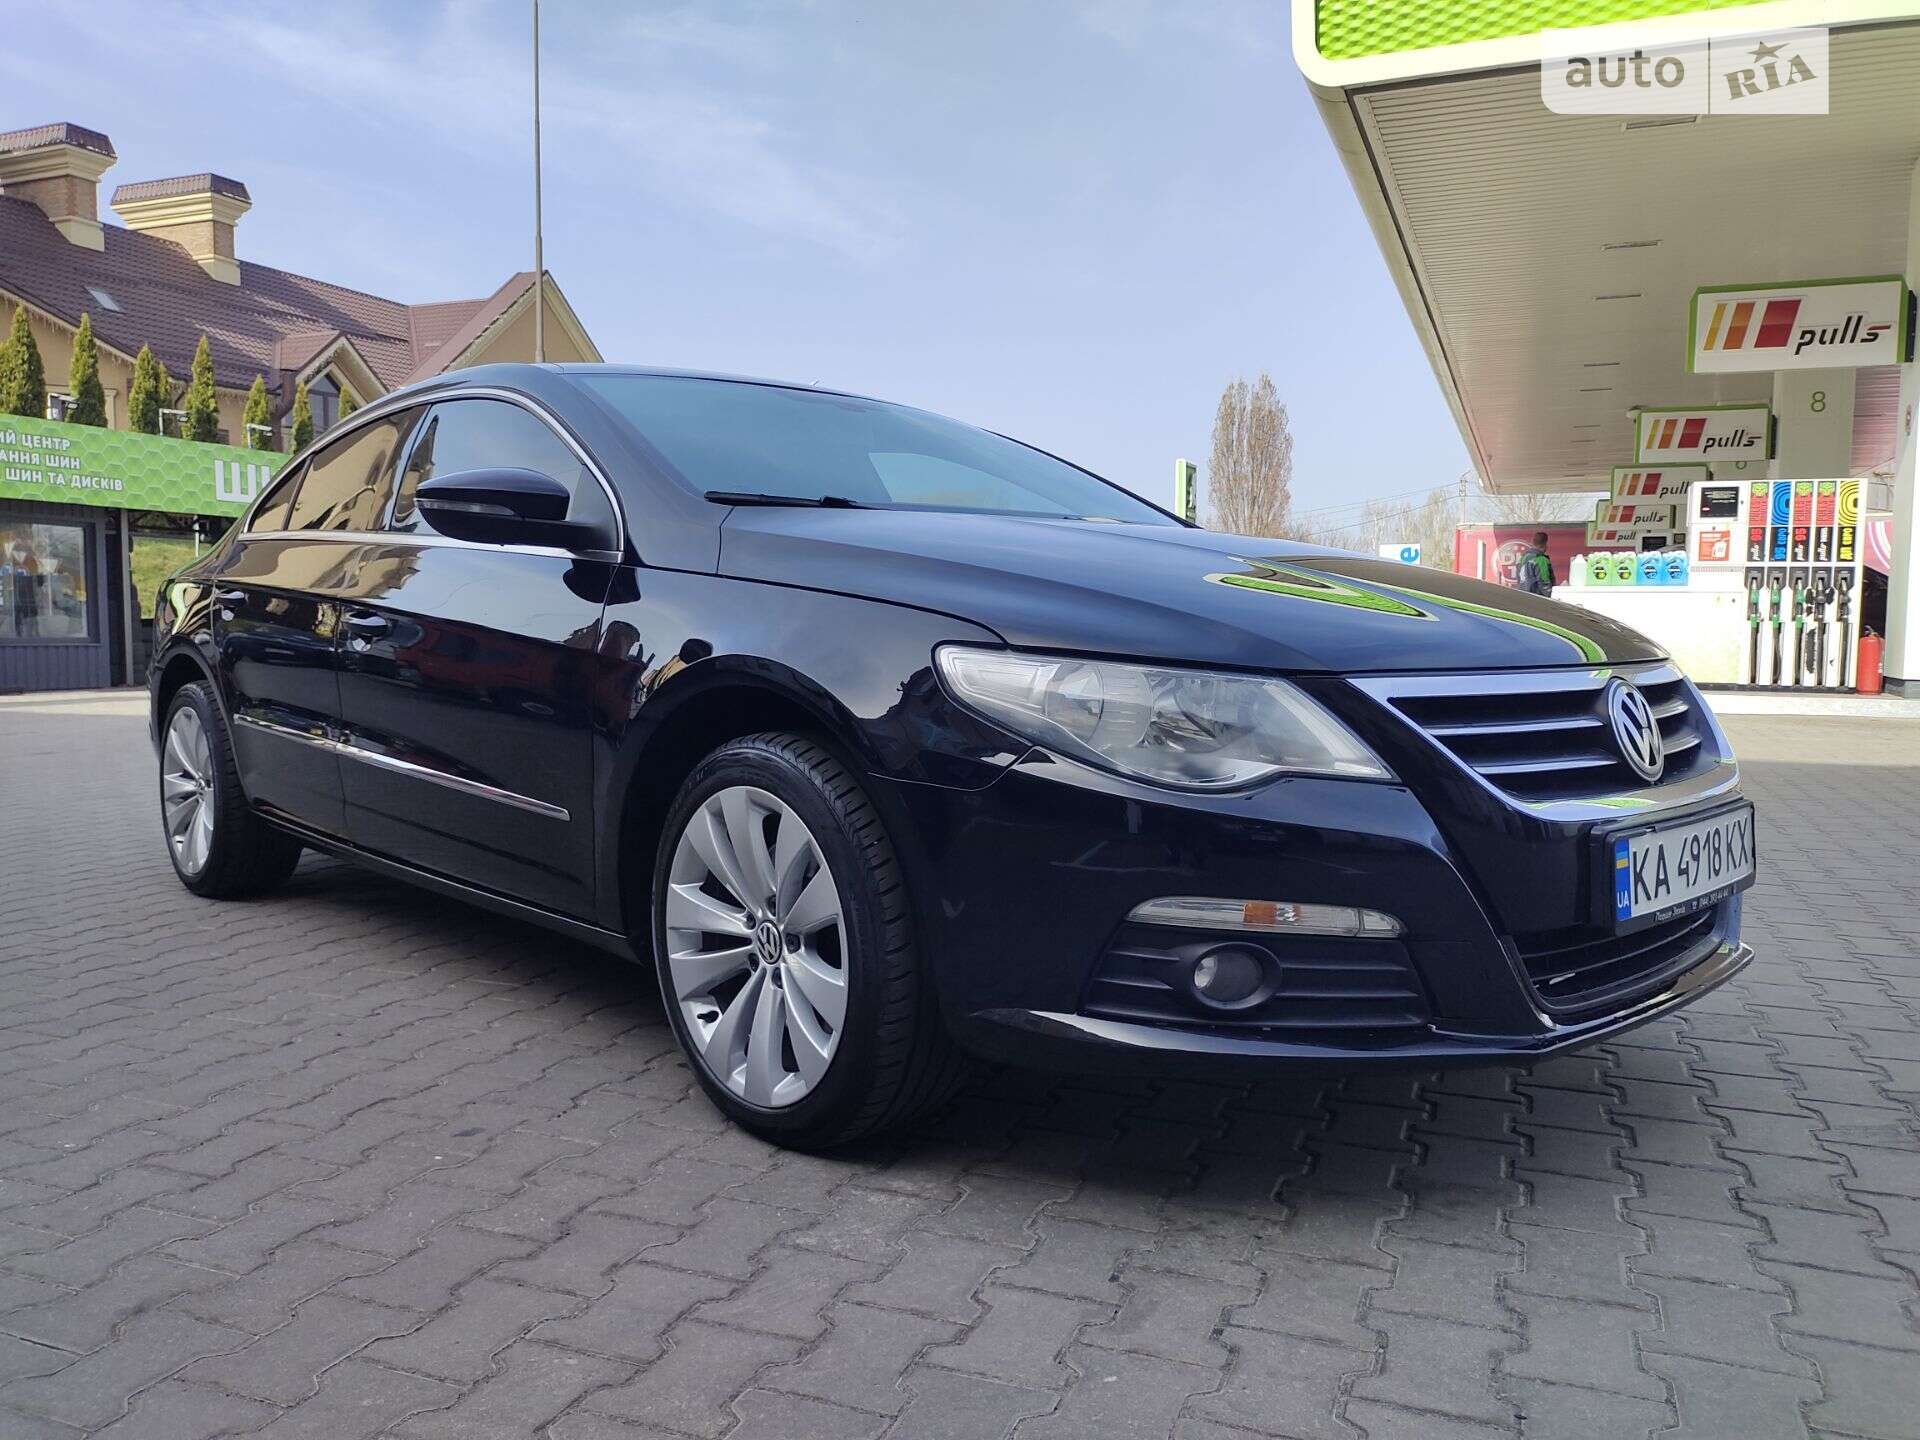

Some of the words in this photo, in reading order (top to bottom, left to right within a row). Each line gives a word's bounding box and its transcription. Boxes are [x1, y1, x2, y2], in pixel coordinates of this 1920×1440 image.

[1794, 315, 1892, 356] pulls
[1811, 391, 1826, 413] 8
[22, 434, 71, 451] ЦЕНТР
[1703, 430, 1763, 454] pulls
[45, 454, 81, 470] ШИН
[5, 467, 42, 483] ШИН
[47, 472, 66, 486] ТА
[71, 475, 124, 491] ДИСКІВ
[1633, 512, 1667, 525] pulls
[1633, 843, 1671, 905] KA
[1677, 827, 1722, 888] 4918
[1727, 816, 1749, 873] KX
[1617, 890, 1630, 909] UA
